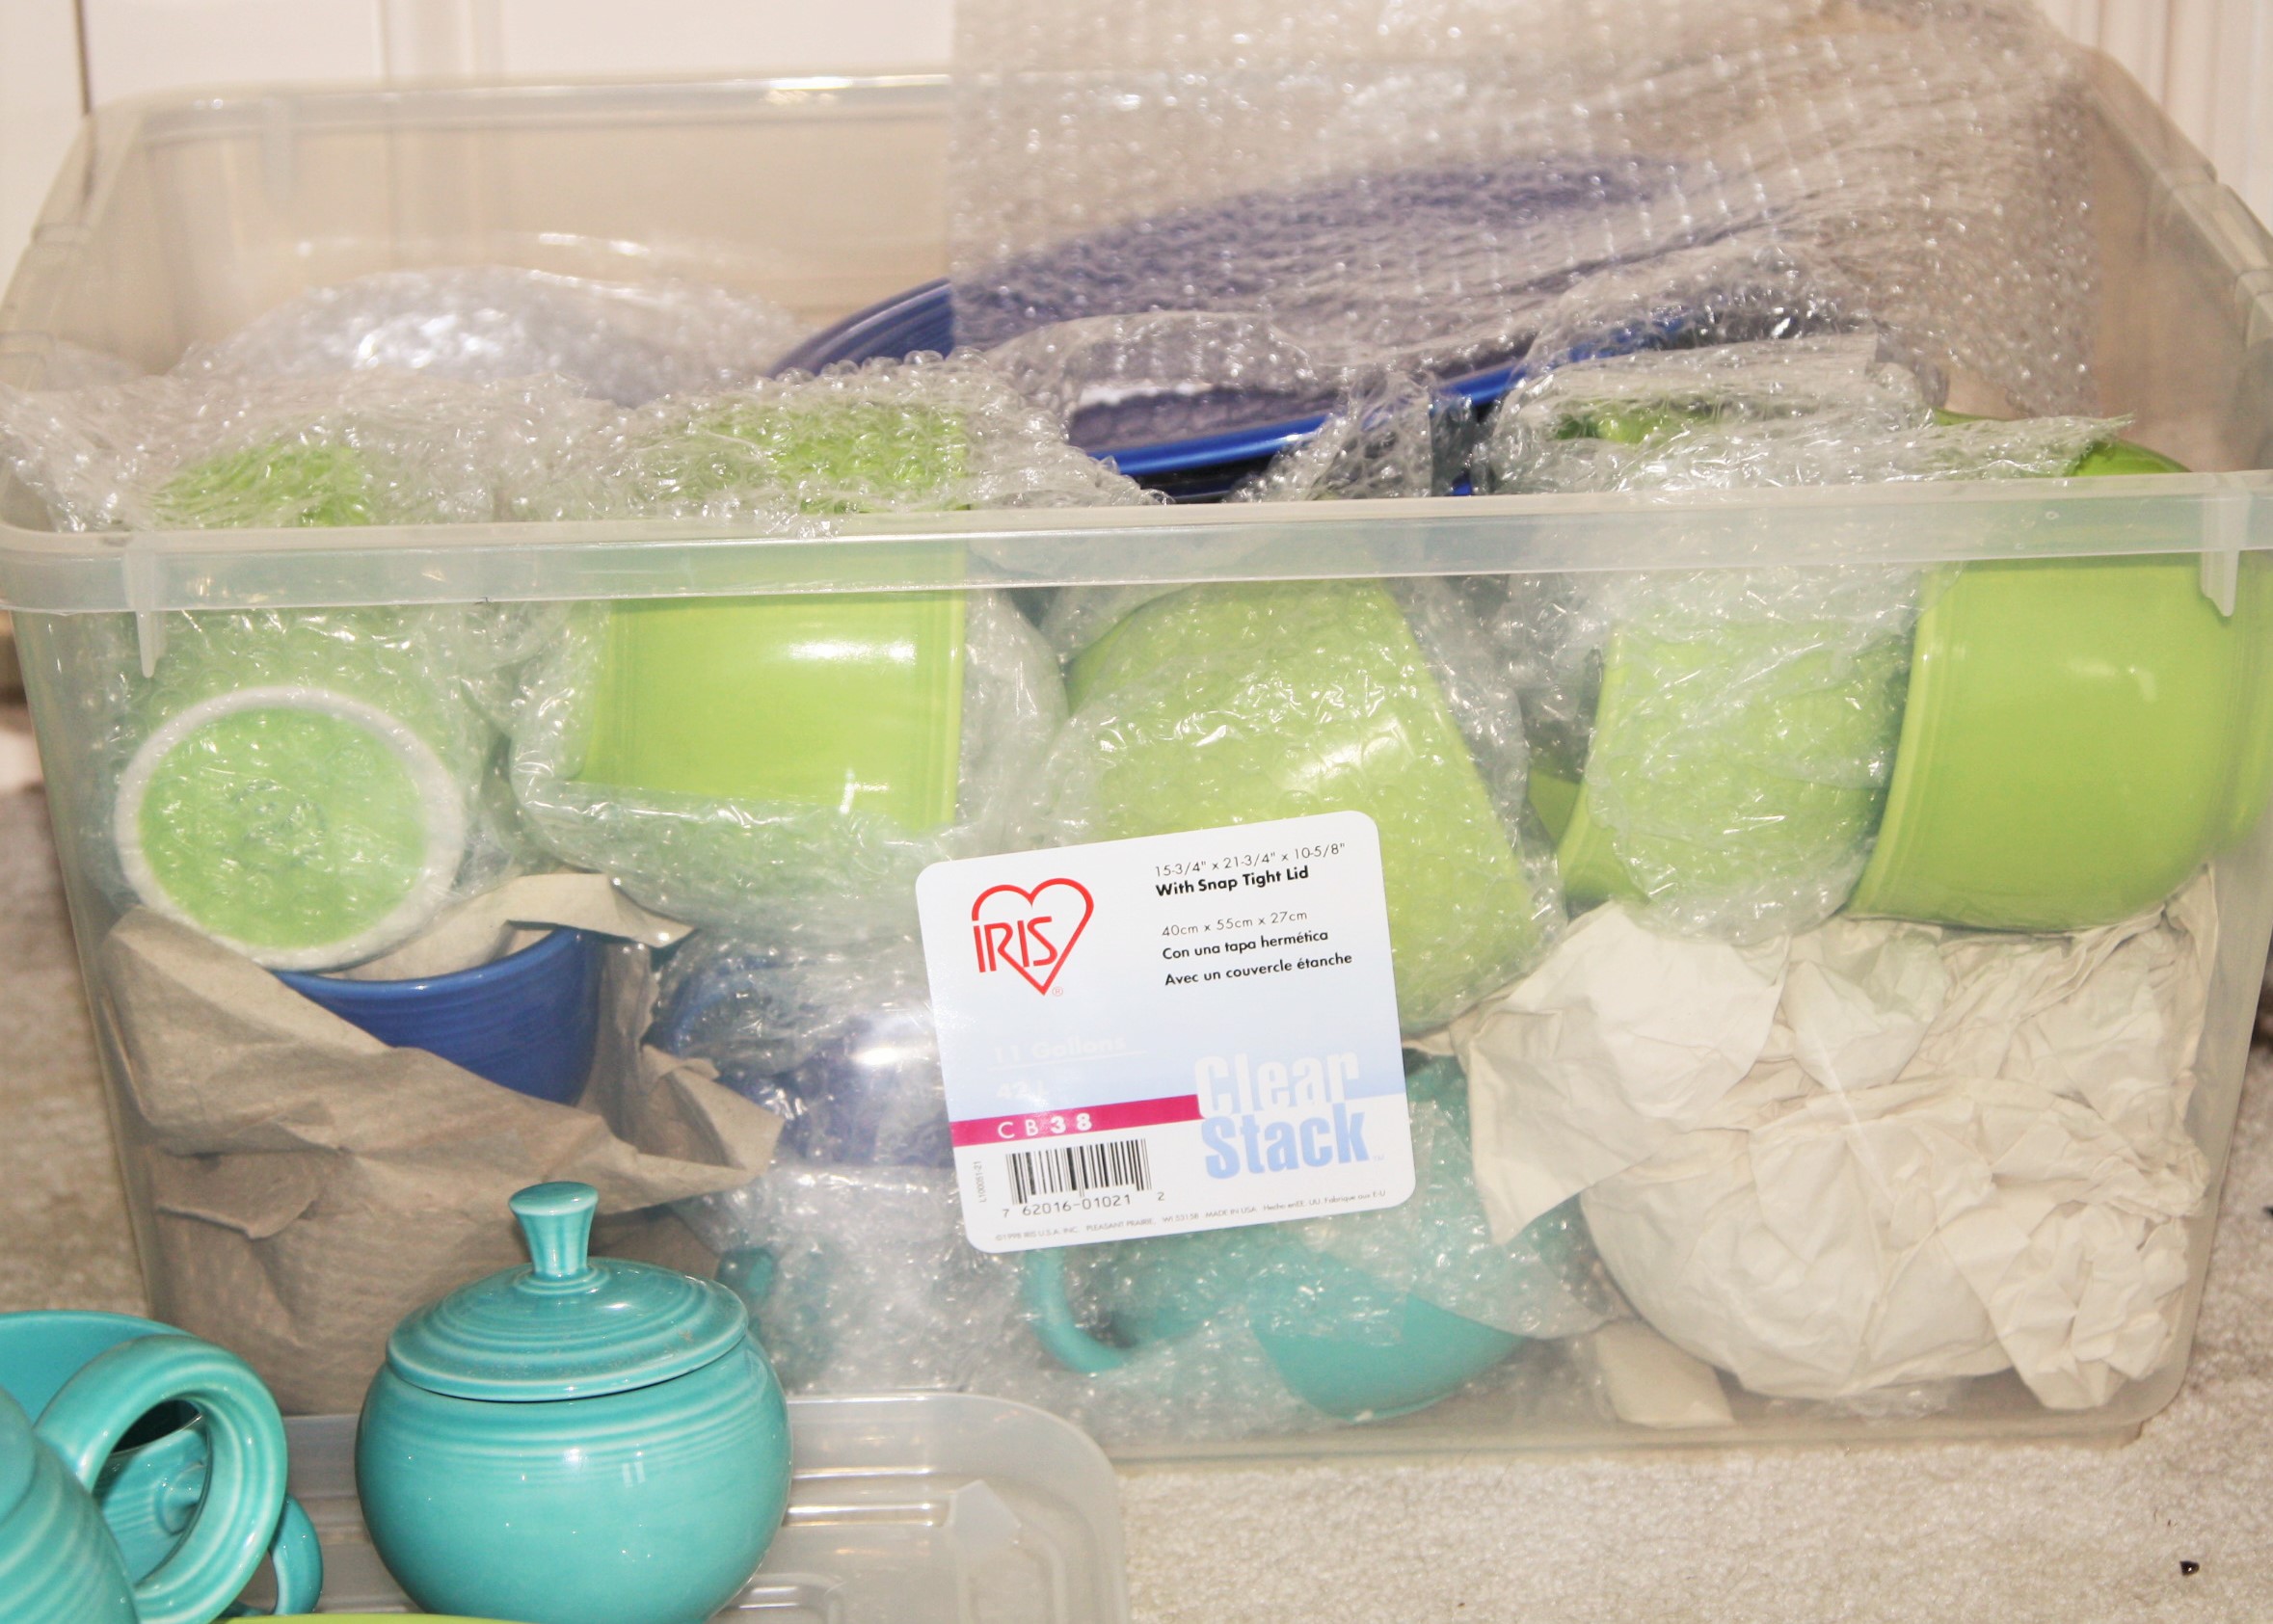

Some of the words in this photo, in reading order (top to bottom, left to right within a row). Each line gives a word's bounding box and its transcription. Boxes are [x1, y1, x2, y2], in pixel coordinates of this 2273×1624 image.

[1156, 861, 1207, 877] 15-3/4"
[1212, 862, 1219, 870] x
[1223, 852, 1276, 869] 21-3/4"
[1281, 853, 1288, 862] x
[1295, 843, 1345, 860] 10-5/8"
[1155, 880, 1194, 896] With
[1198, 877, 1238, 892] Snap
[1243, 870, 1282, 888] Tight
[1287, 865, 1309, 880] Lid
[1162, 924, 1198, 937] 40cm
[1204, 923, 1211, 932] x
[1217, 918, 1253, 931] 55cm
[1258, 917, 1266, 925] x
[1270, 911, 1307, 924] 27cm
[973, 916, 1057, 972] IRIS
[1163, 946, 1190, 960] Con
[1194, 945, 1220, 956] una
[1225, 941, 1256, 954] tapa
[1261, 931, 1328, 947] hermética
[1164, 973, 1198, 986] Avec
[1204, 970, 1221, 981] un
[1226, 959, 1292, 979] couvercle
[1297, 951, 1352, 970] étanche
[1031, 1035, 1127, 1059] Gallons
[1194, 1051, 1360, 1119] Clear
[1201, 1103, 1370, 1180] Stack
[1022, 1194, 1132, 1216] 62016-01021
[1158, 1191, 1164, 1202] 2
[1205, 1209, 1229, 1218] MADE
